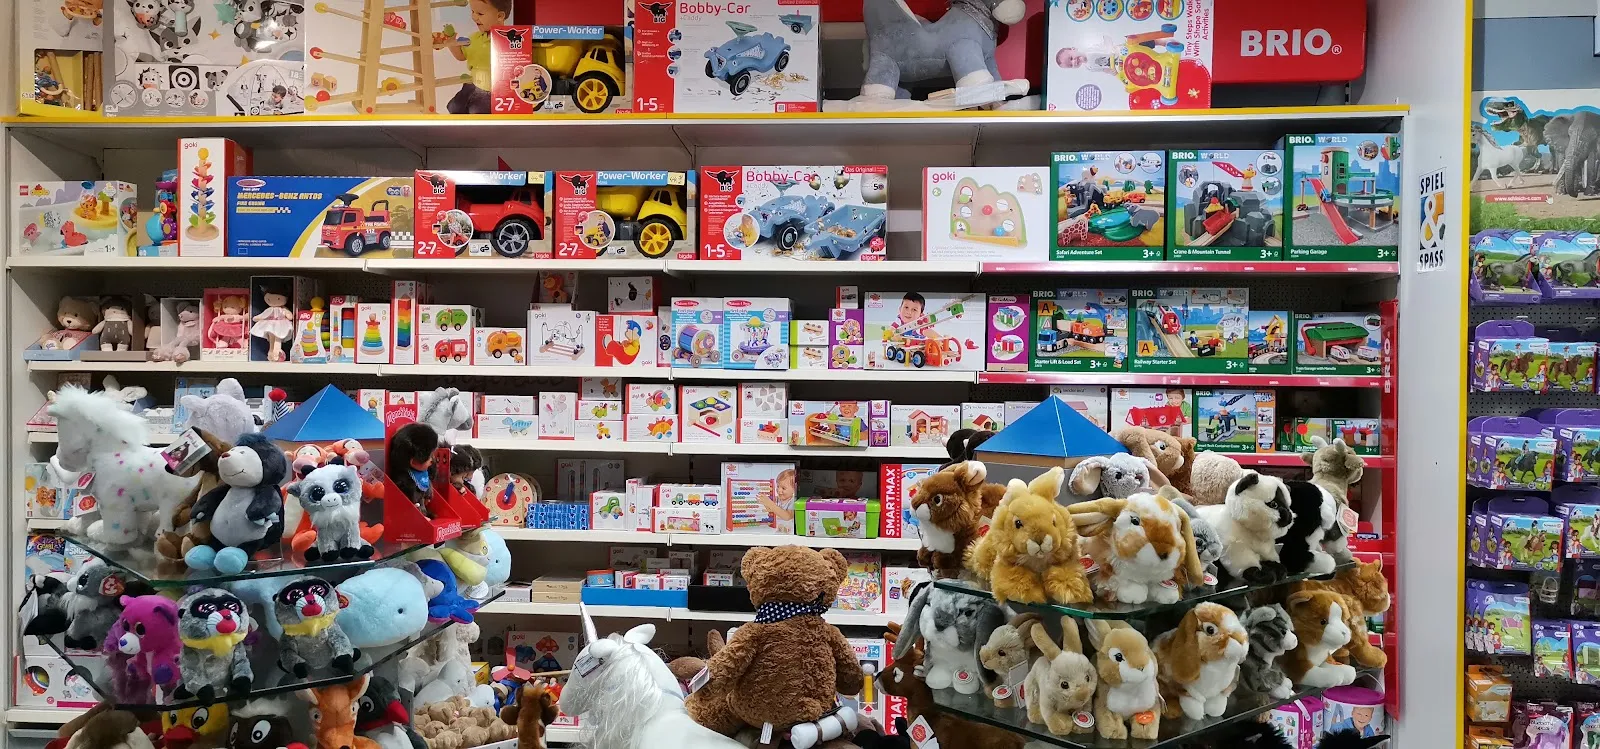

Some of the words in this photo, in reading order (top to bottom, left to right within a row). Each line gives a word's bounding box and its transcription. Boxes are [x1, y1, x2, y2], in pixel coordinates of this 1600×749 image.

[680, 3, 751, 16] Bobby-Car
[1185, 20, 1193, 40] Steps
[1193, 18, 1202, 40] Shape
[1202, 8, 1210, 40] Activities
[533, 26, 603, 36] Power-Worker
[1241, 28, 1333, 56] BRIO
[1185, 41, 1193, 57] Tiny
[494, 97, 515, 111] 2-7
[636, 97, 658, 111] 1-5
[1289, 136, 1313, 144] BRIO
[1054, 154, 1078, 162] BRIO
[597, 171, 666, 180] Power-Worker
[932, 171, 956, 183] goki
[1420, 171, 1444, 195] SPIEL
[417, 241, 437, 255] 2-7
[558, 242, 579, 256] 2-7
[704, 243, 726, 258] 1-5
[1143, 249, 1155, 258] 3+
[1260, 249, 1273, 259] 3+
[1377, 249, 1390, 258] 3+
[1419, 249, 1443, 268] SPASS
[1033, 290, 1055, 298] BRIO
[1041, 303, 1050, 313] A
[1141, 343, 1150, 353] A
[1090, 360, 1102, 369] 3+
[1225, 360, 1238, 370] 3+
[885, 468, 896, 536] SMARTMAX
